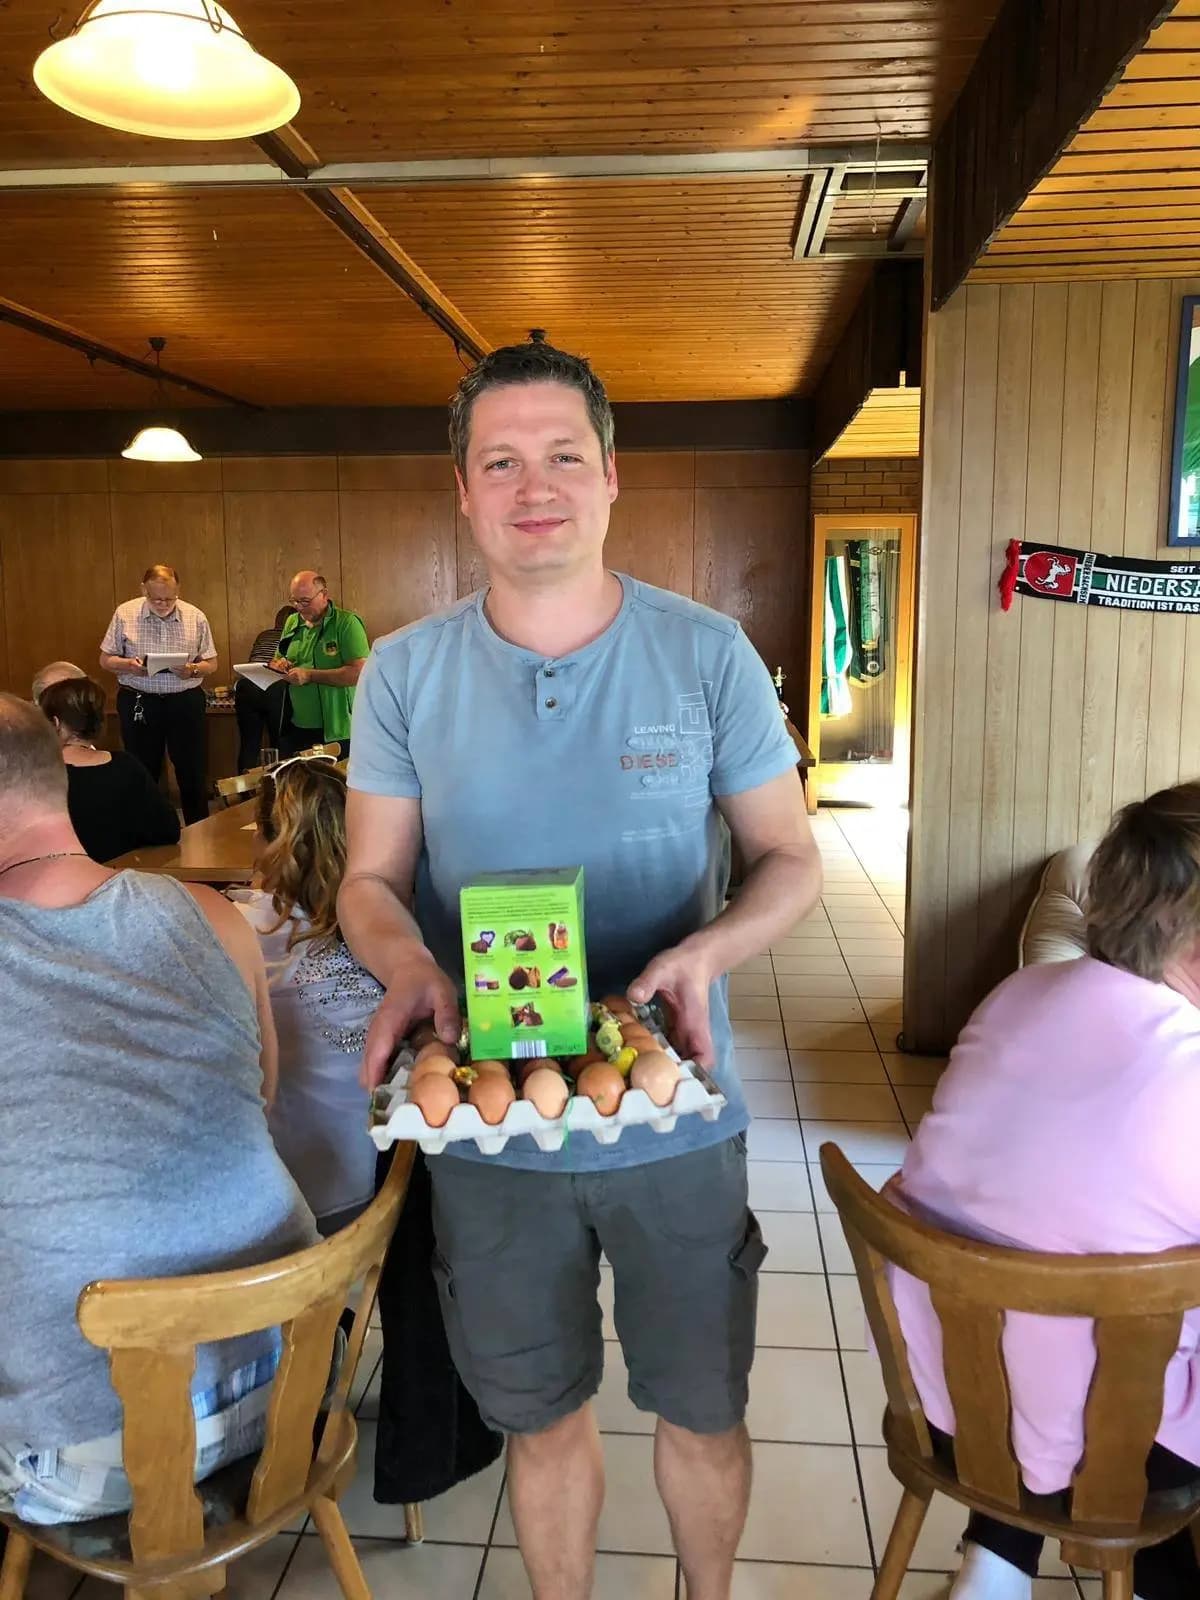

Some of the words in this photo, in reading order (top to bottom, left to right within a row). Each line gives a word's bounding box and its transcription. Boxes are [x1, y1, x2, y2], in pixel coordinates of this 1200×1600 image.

[1169, 565, 1196, 574] SEIT
[1097, 596, 1155, 610] TRADITION
[1157, 602, 1174, 611] IST
[1176, 603, 1200, 613] DAS
[634, 724, 677, 735] LEAVING
